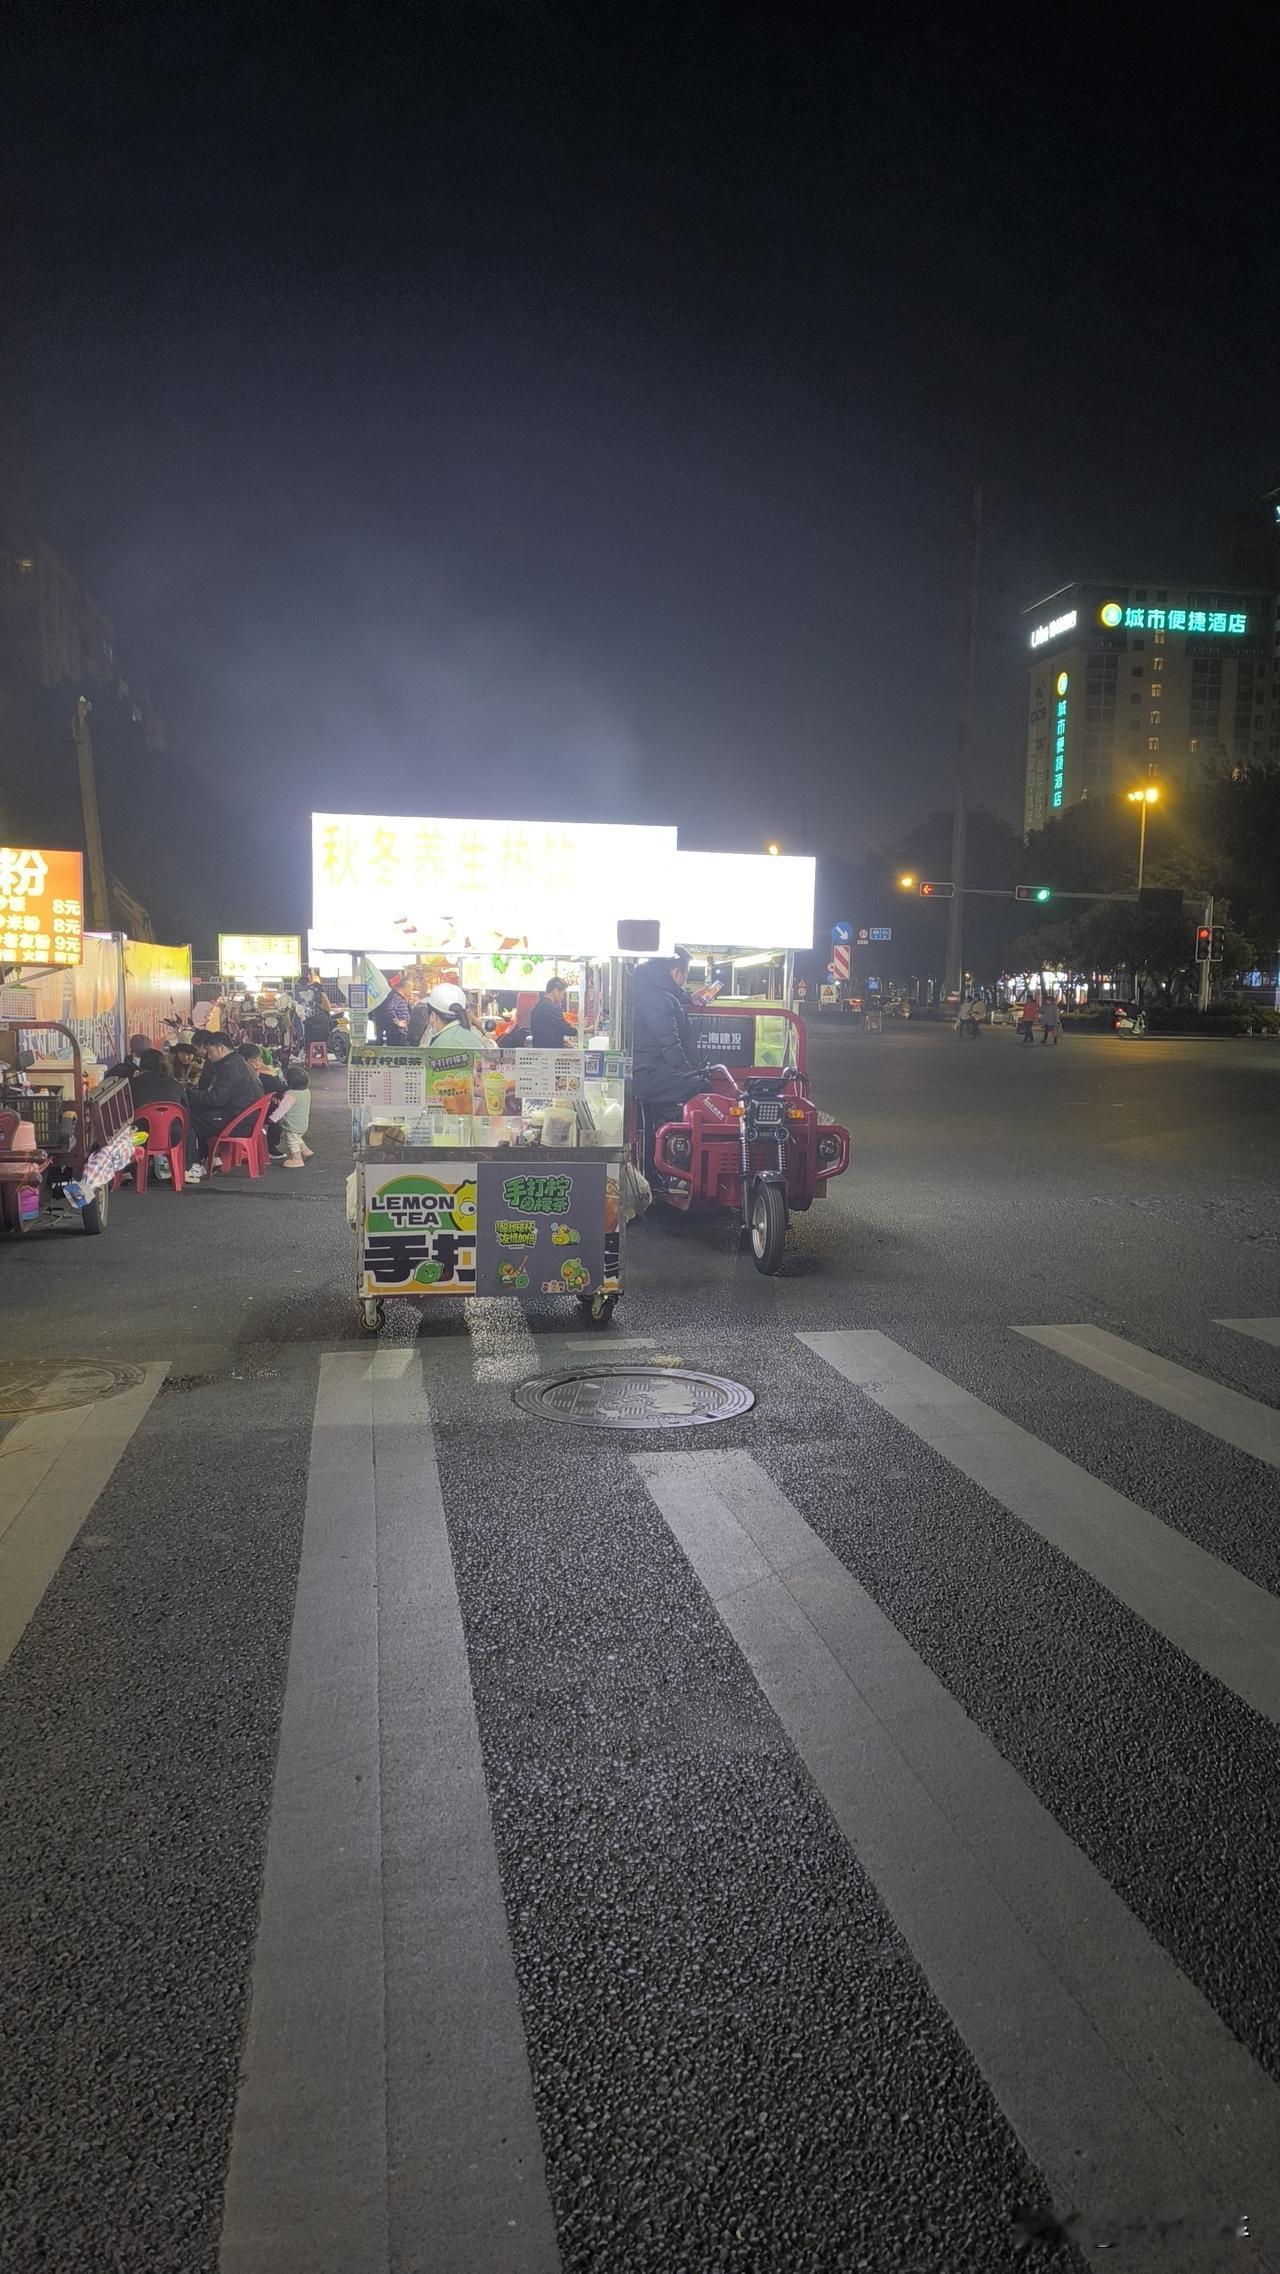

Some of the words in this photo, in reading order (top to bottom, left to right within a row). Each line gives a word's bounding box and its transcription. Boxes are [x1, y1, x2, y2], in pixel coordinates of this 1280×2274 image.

[1125, 607, 1248, 633] 城市便捷酒店
[0, 848, 48, 897] 粉
[52, 898, 80, 916] 8元
[52, 917, 80, 935] 8元
[54, 935, 80, 952] 9元
[371, 1196, 455, 1211] LEMON
[391, 1211, 439, 1225] TEA
[364, 1234, 477, 1283] 手打
